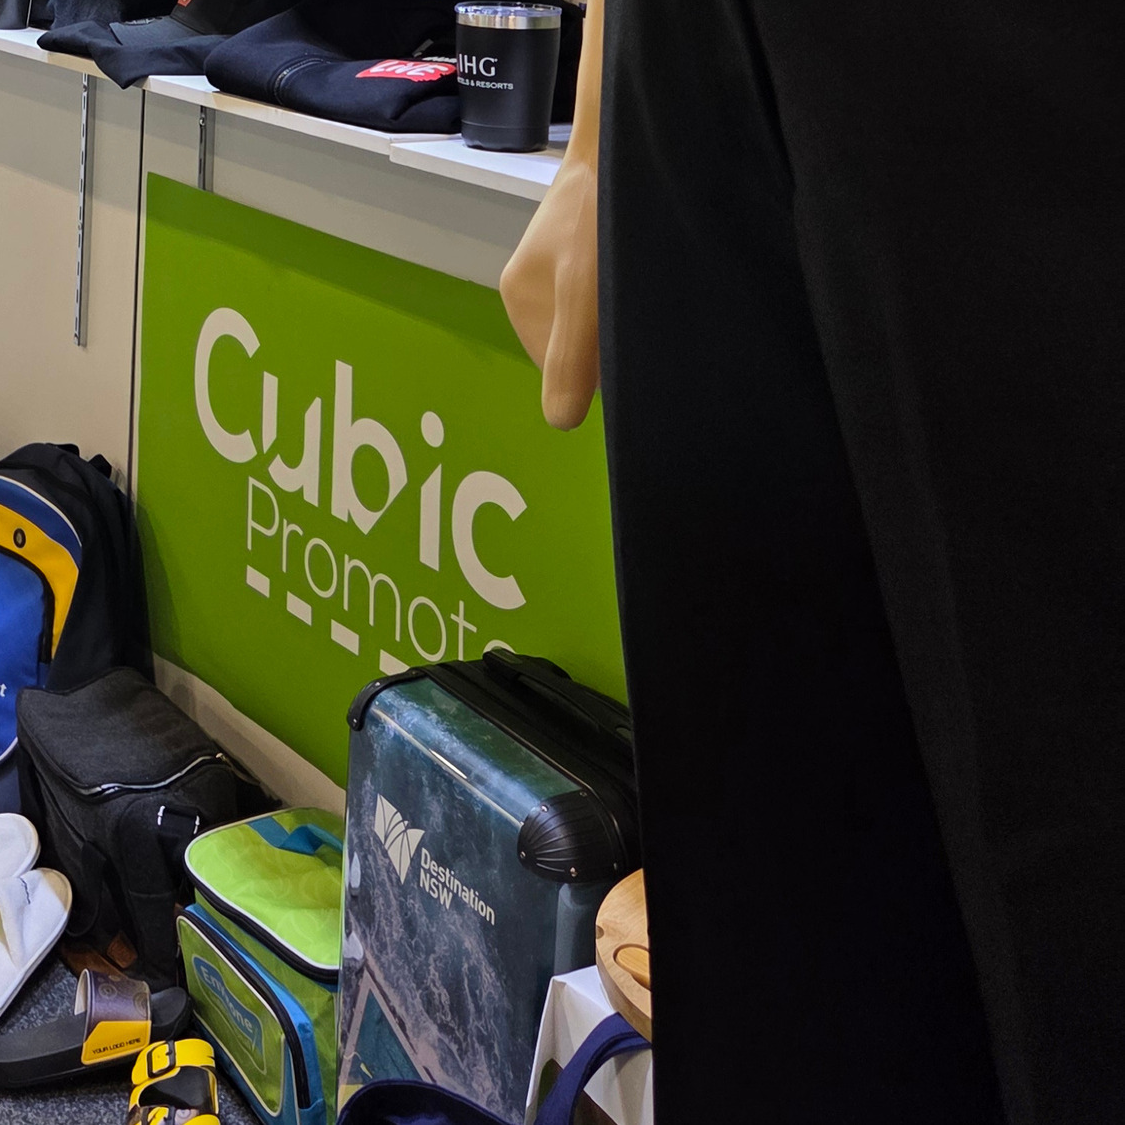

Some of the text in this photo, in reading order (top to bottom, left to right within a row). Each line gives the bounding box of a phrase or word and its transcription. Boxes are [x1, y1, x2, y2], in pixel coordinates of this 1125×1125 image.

[459, 54, 496, 77] IHG
[475, 80, 514, 90] RESORTS
[194, 307, 527, 610] Cubic
[247, 476, 517, 662] Promot
[419, 867, 453, 910] NSW
[420, 847, 495, 926] Destination
[92, 1038, 141, 1054] YOUR LOGO HERE
